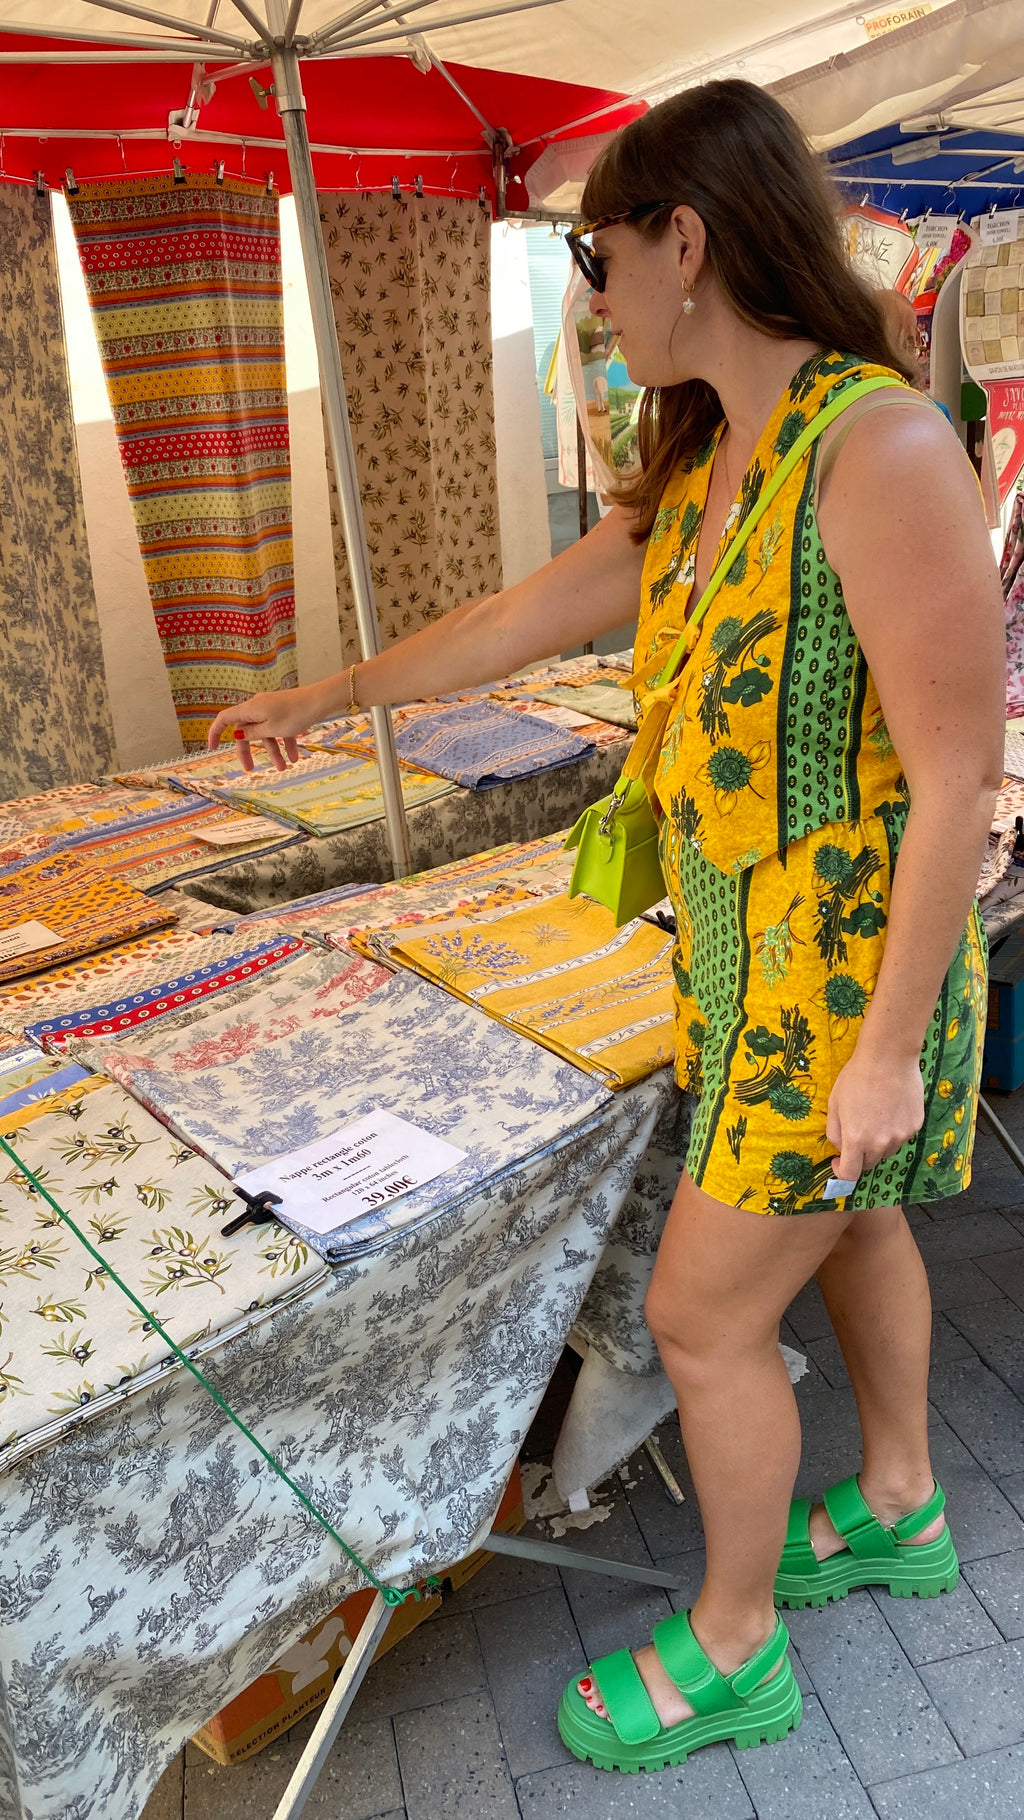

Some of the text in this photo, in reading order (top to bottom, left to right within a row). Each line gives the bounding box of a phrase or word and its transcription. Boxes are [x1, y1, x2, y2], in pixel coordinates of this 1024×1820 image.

[865, 8, 926, 32] PROFORAIN
[987, 220, 1010, 229] TORCHON
[279, 1131, 378, 1183] Nappe rectangle coton
[311, 1148, 373, 1182] 3m x 1m60
[322, 1180, 362, 1204] Rectangular
[361, 1174, 418, 1208] 39,00€
[368, 1179, 379, 1188] 64
[281, 1687, 326, 1725] PLANTEUR
